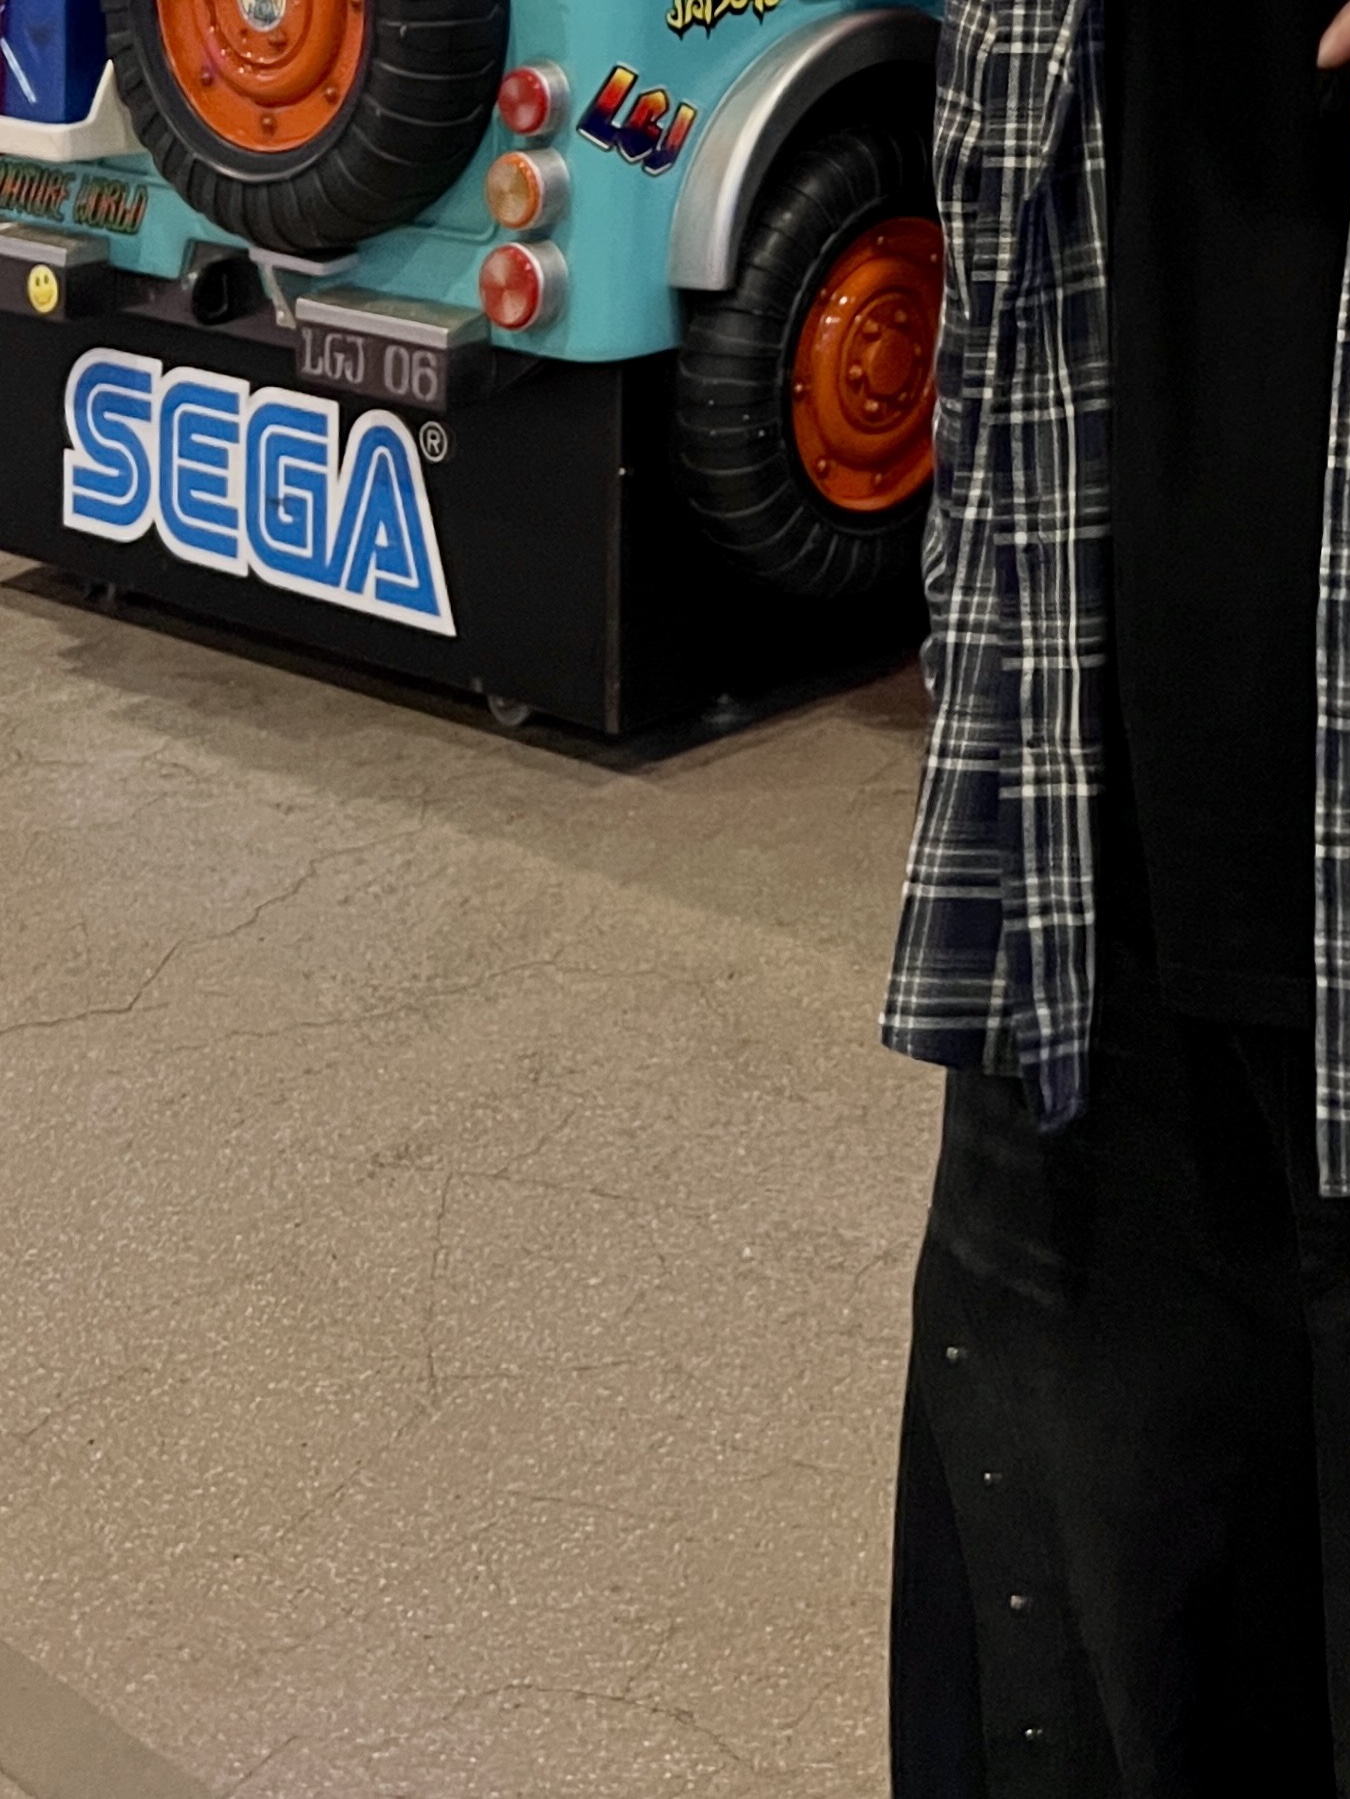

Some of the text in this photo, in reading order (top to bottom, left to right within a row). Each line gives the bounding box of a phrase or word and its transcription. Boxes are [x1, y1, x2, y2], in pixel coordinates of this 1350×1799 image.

[302, 327, 438, 402] LGJ 06
[64, 348, 457, 637] SEGA
